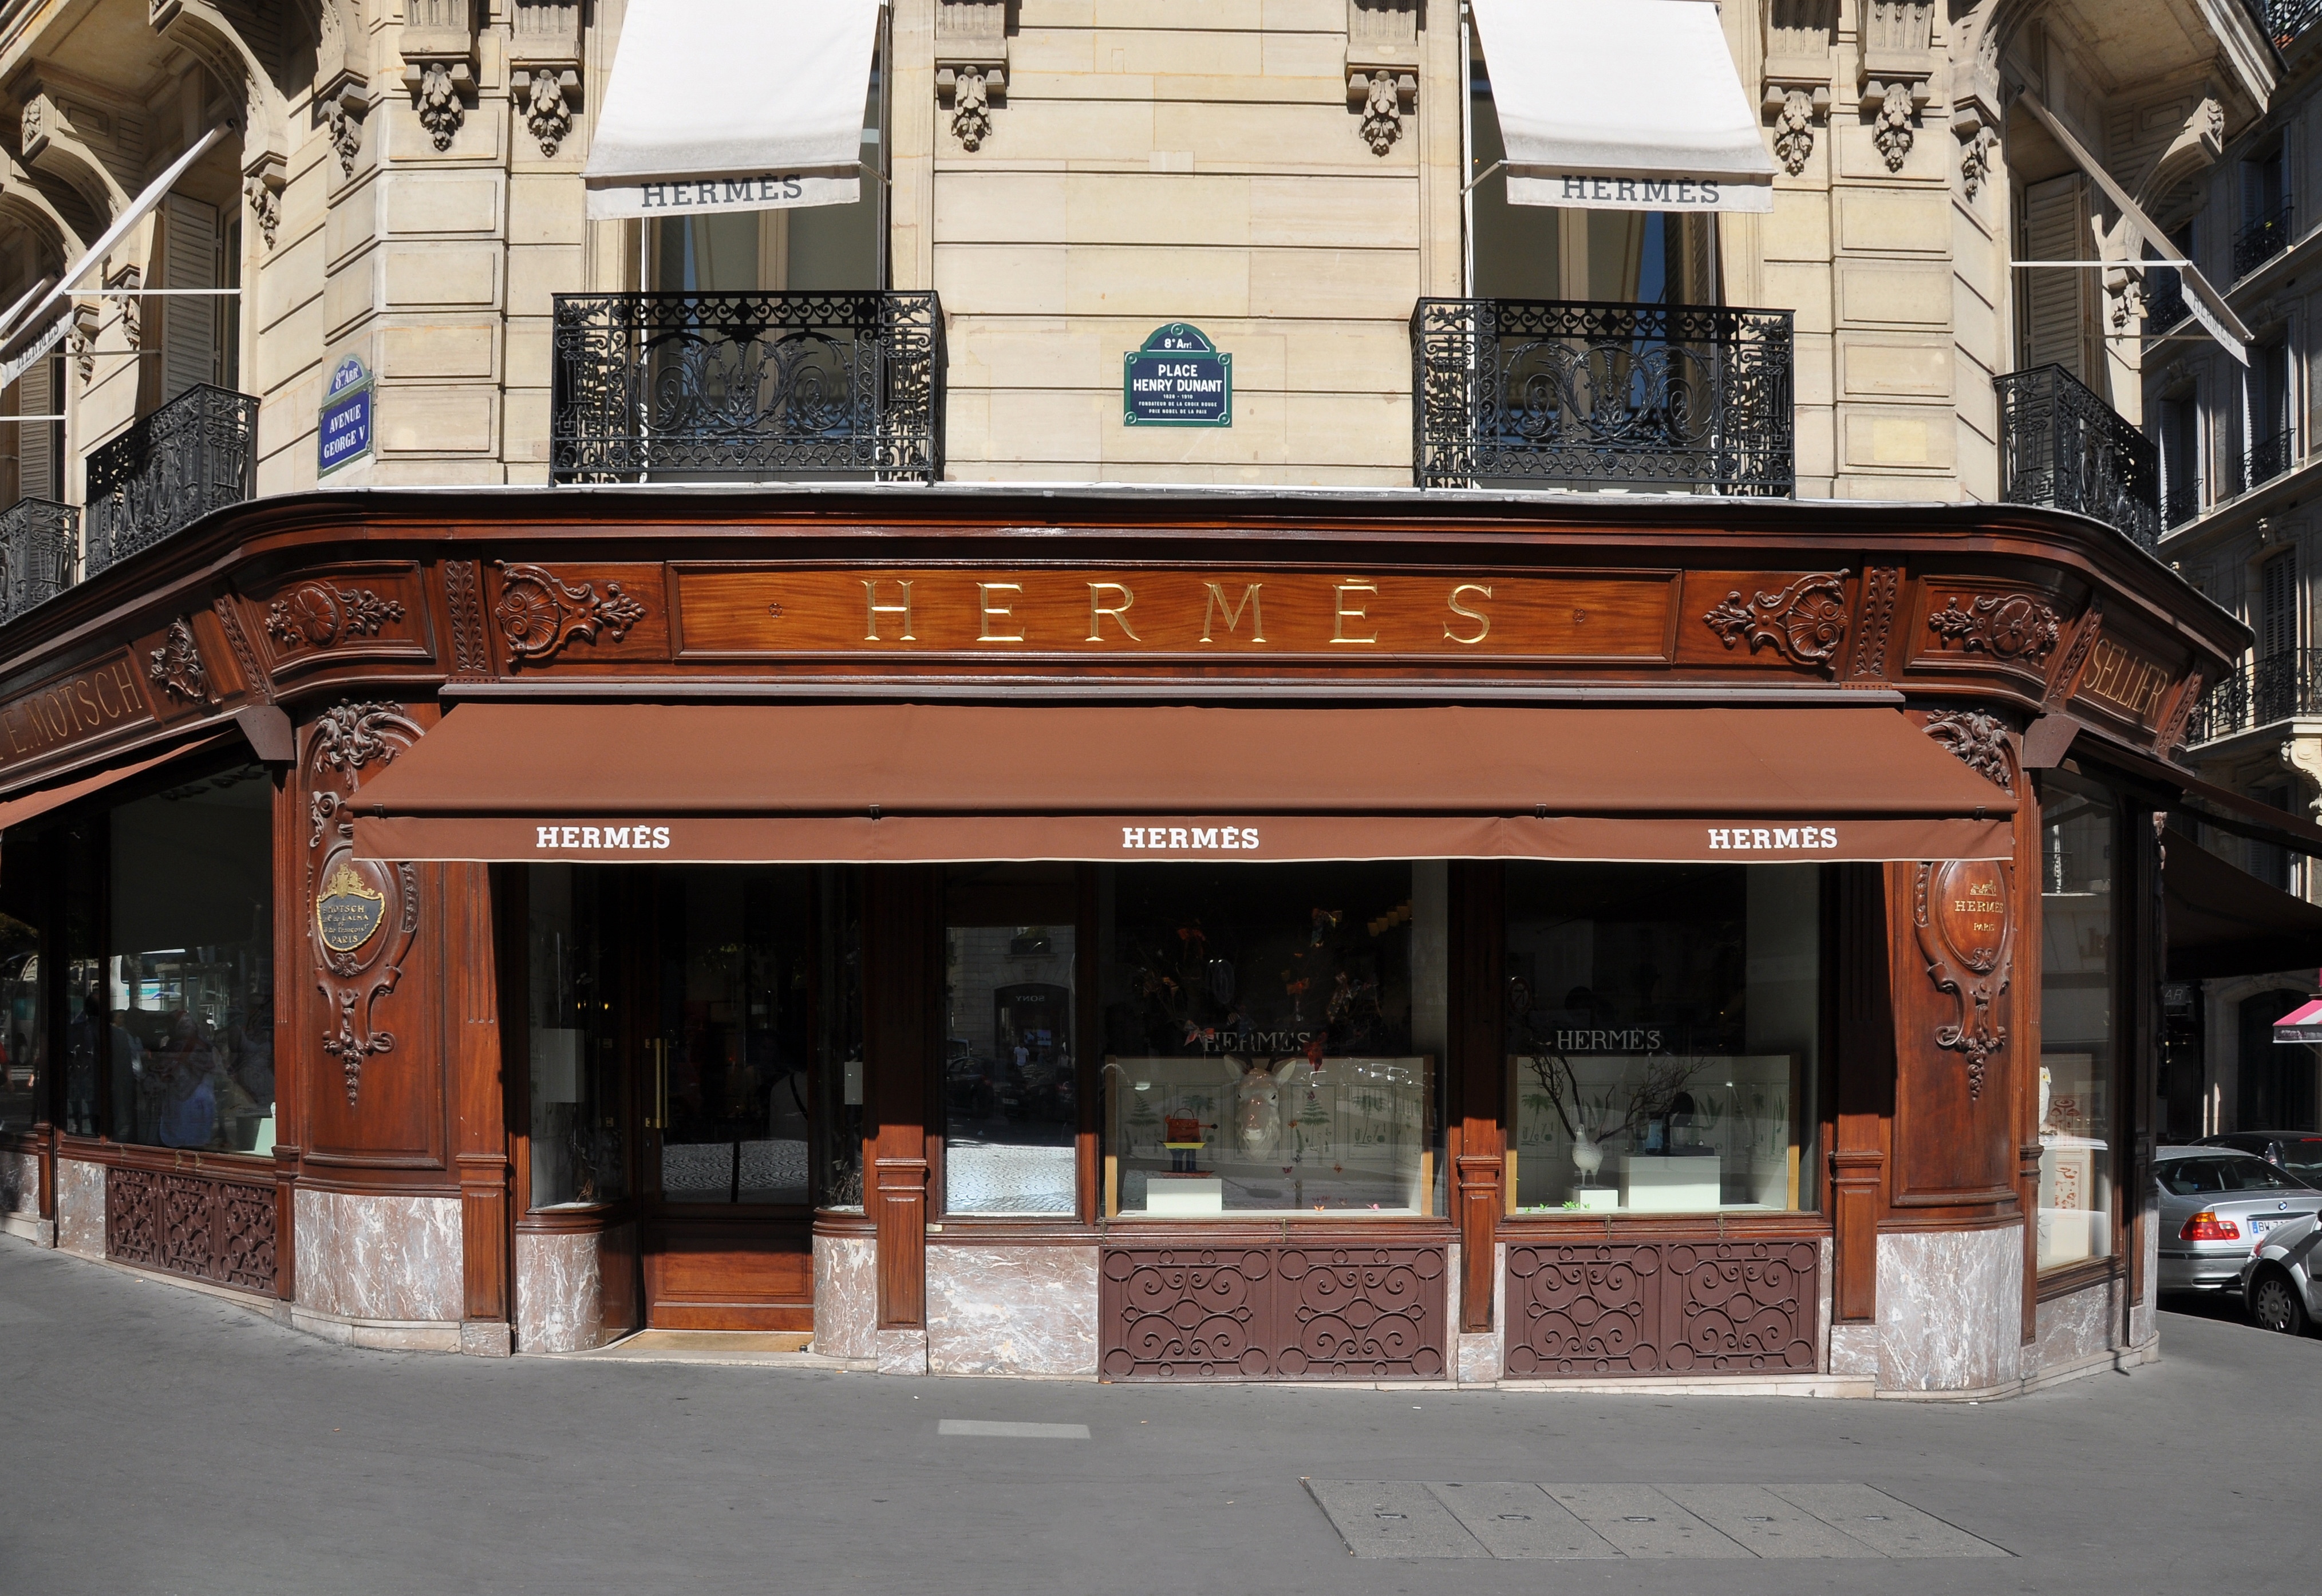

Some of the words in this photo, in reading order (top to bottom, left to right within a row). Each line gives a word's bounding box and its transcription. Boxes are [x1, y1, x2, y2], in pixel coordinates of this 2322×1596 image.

[641, 173, 802, 207] HERMÈS
[1561, 175, 1720, 203] HERMÈS
[1158, 364, 1198, 377] PLACE
[1134, 379, 1172, 392] HENRY
[1177, 380, 1222, 392] DUNANT
[329, 404, 361, 433] AVENUE
[324, 430, 356, 458] GEORGE
[359, 425, 365, 440] V
[2083, 638, 2168, 719] SELLIER
[536, 825, 670, 849] HERMÈS
[1122, 826, 1259, 849] HERMÈS
[1708, 826, 1838, 849] HERMÈS
[1974, 923, 1995, 931] PARIS
[331, 935, 358, 943] PARIS
[1556, 1028, 1660, 1050] HERMÈS
